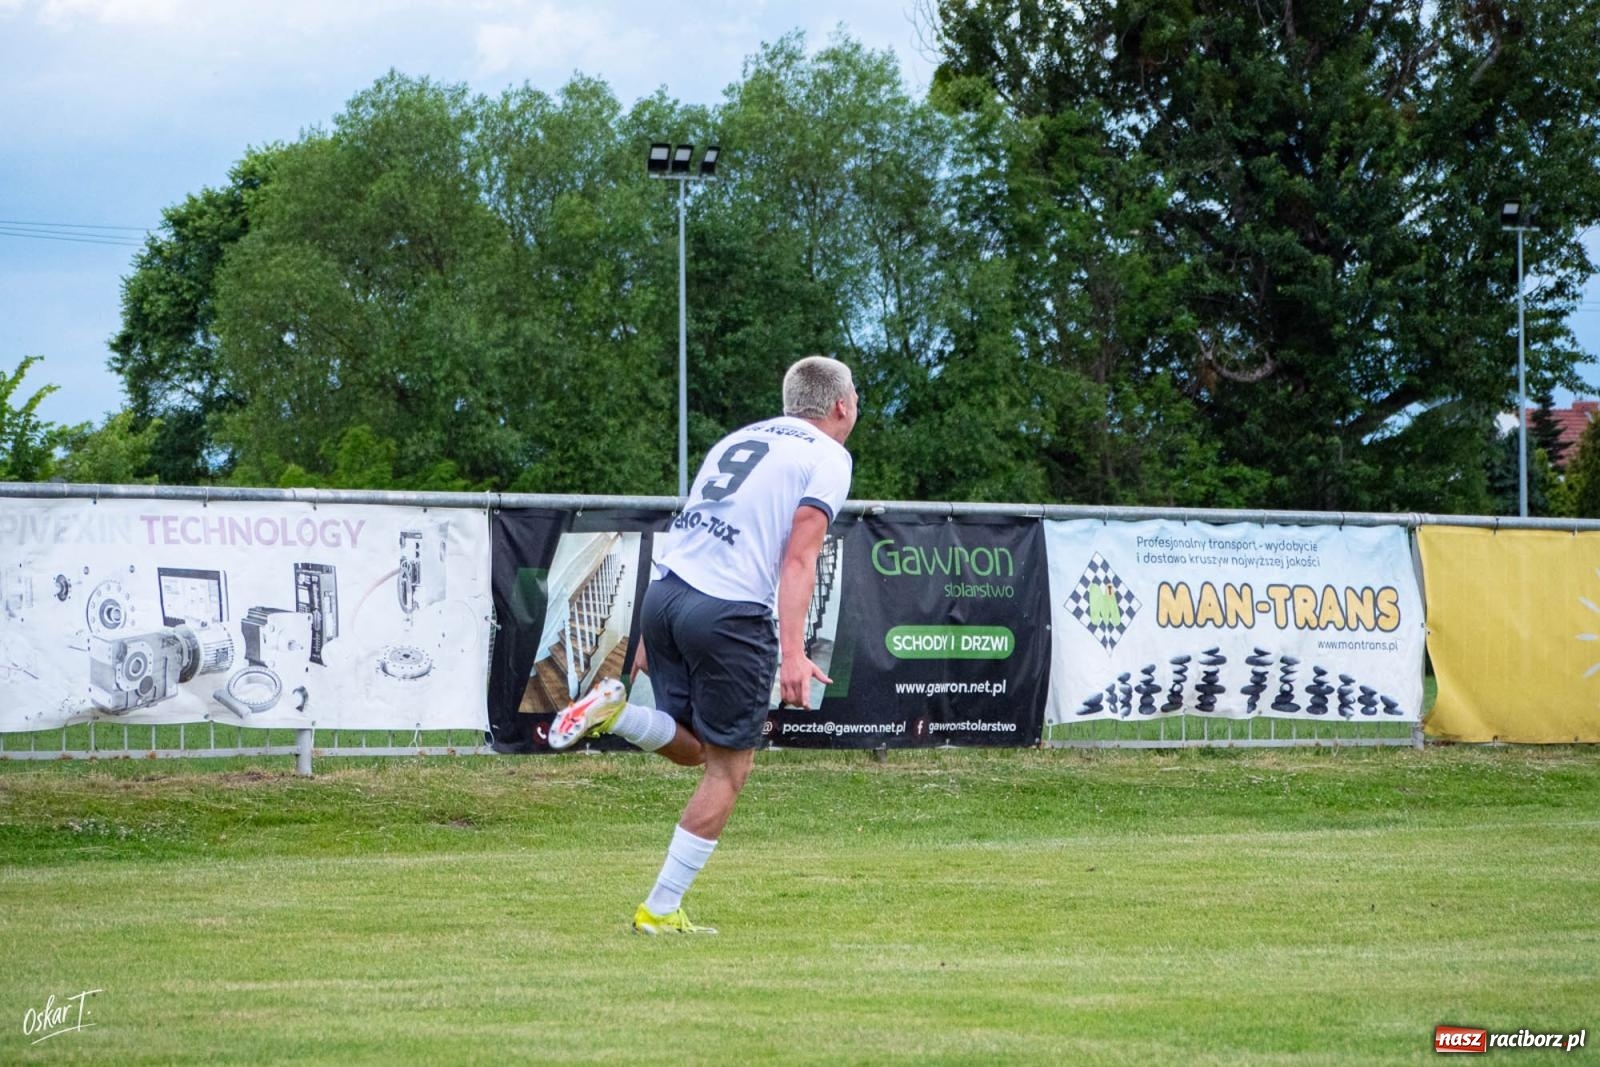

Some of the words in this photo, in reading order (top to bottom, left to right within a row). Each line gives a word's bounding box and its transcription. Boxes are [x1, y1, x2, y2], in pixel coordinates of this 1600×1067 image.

[701, 439, 770, 502] 9
[140, 514, 367, 549] TECHNOLOGY
[1136, 536, 1206, 551] Profesjonalny
[1208, 539, 1258, 553] transport
[1265, 541, 1318, 554] wydobycie
[871, 538, 1014, 577] Gawron
[1143, 552, 1187, 565] dostawa
[1189, 554, 1230, 567] kruszyw
[1231, 555, 1285, 569] najwyższej
[1286, 555, 1321, 570] jakości
[944, 582, 1015, 599] stolarstwo
[1157, 581, 1400, 633] MAN-TRANS
[892, 635, 948, 652] SCHODY
[961, 636, 1009, 652] DRZWI
[1318, 641, 1399, 652] www.mantrans.pl
[895, 678, 1008, 697] www.gawron.net.pl
[782, 721, 907, 736] poczta@gawron.net.pl
[928, 720, 1017, 735] gawronstolarstwo
